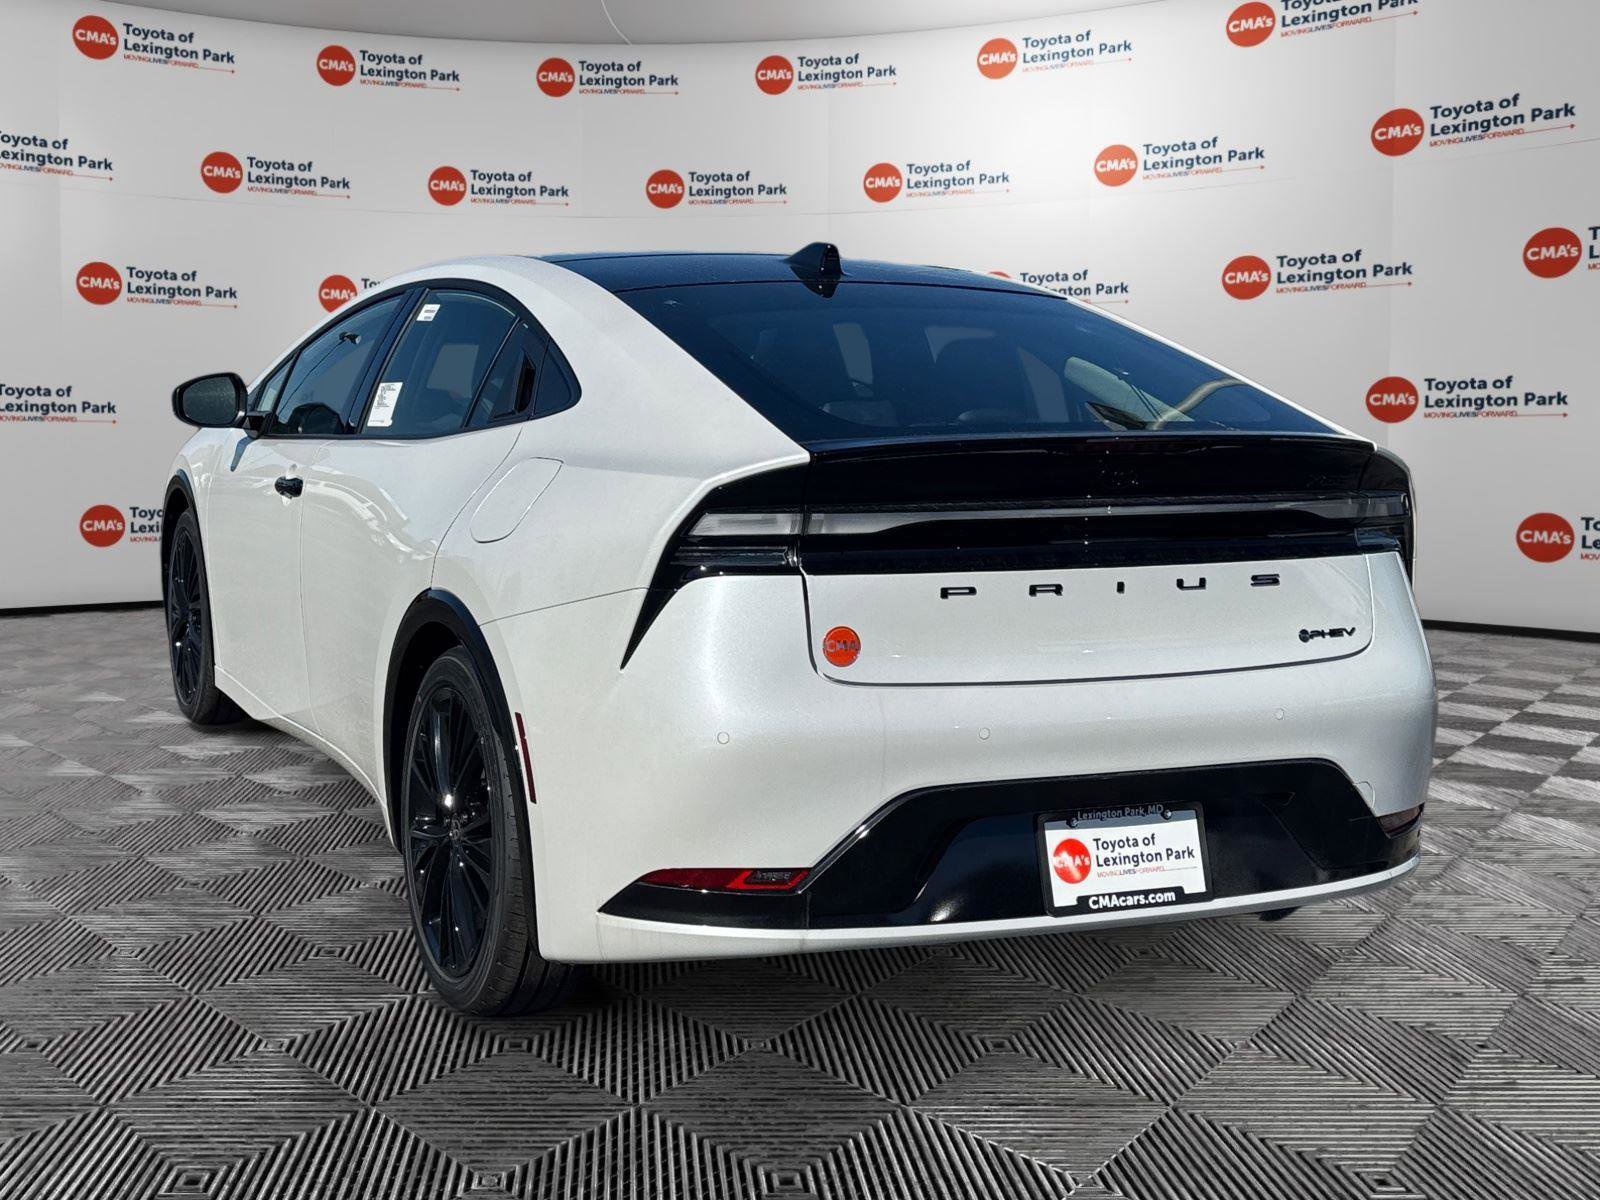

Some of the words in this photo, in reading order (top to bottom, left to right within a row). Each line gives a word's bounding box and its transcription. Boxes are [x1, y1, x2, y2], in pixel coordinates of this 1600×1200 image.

[1281, 2, 1372, 28] Lexington
[122, 22, 175, 41] Toyota
[177, 31, 194, 43] of
[1228, 15, 1273, 33] CMA's
[74, 29, 118, 48] CMA's
[1021, 33, 1072, 50] Toyota
[1074, 29, 1091, 42] of
[123, 38, 198, 64] Lexington
[202, 48, 235, 64] Park
[359, 49, 405, 65] Toyota
[407, 53, 423, 65] of
[978, 51, 1017, 65] CMA's
[1022, 46, 1094, 64] Lexington
[1098, 40, 1132, 55] Park
[318, 59, 355, 74] CMA's
[578, 60, 624, 74] Toyota
[626, 60, 642, 71] of
[796, 55, 842, 69] Toyota
[844, 52, 860, 64] of
[360, 64, 426, 84] Lexington
[430, 69, 460, 82] Park
[538, 71, 574, 84] CMA's
[578, 74, 645, 90] Lexington
[648, 74, 678, 86] Park
[757, 68, 793, 81] CMA's
[797, 68, 863, 83] Lexington
[866, 65, 896, 78] Park
[1429, 99, 1494, 120] Toyota
[1498, 92, 1520, 108] of
[1430, 113, 1524, 136] Lexington
[1530, 103, 1575, 122] Park
[0, 130, 48, 148] oyota
[52, 138, 69, 150] of
[1374, 123, 1423, 140] CMA's
[1142, 140, 1196, 157] Toyota
[1200, 135, 1218, 149] of
[0, 149, 74, 167] exington
[78, 155, 113, 171] Park
[246, 156, 294, 172] Toyota
[297, 160, 313, 172] of
[1096, 158, 1137, 172] CMA's
[1142, 154, 1222, 171] Lexington
[1227, 146, 1265, 162] Park
[202, 165, 242, 181] CMA's
[469, 169, 515, 184] Toyota
[517, 170, 532, 182] of
[905, 162, 953, 177] Toyota
[955, 159, 971, 171] of
[247, 171, 316, 191] Lexington
[320, 176, 350, 189] Park
[687, 171, 733, 185] Toyota
[735, 170, 750, 181] of
[864, 176, 902, 188] CMA's
[906, 175, 974, 190] Lexington
[978, 171, 1010, 185] Park
[429, 180, 466, 193] CMA's
[470, 183, 536, 200] Lexington
[539, 185, 569, 197] Park
[647, 183, 684, 195] CMA's
[688, 184, 754, 200] Lexington
[757, 183, 787, 195] Park
[1276, 252, 1337, 270] Toyota
[1341, 248, 1362, 262] of
[1526, 243, 1579, 261] CMA's
[125, 266, 178, 282] Toyota
[180, 270, 197, 282] of
[1020, 271, 1069, 285] Toyota
[1072, 269, 1089, 281] of
[1224, 270, 1270, 284] CMA's
[1276, 268, 1366, 284] Lexington
[1371, 261, 1414, 277] Park
[78, 276, 121, 292] CMA's
[126, 281, 201, 301] Lexington
[205, 285, 237, 299] Park
[1095, 282, 1129, 295] Park
[55, 385, 73, 397] of
[1423, 377, 1487, 394] Toyota
[1491, 374, 1513, 389] of
[81, 401, 117, 414] Park
[1369, 392, 1417, 407] CMA's
[1424, 394, 1518, 412] Lexington
[1524, 391, 1568, 406] Park
[82, 519, 124, 532] CMA's
[1520, 529, 1571, 545] CMA's
[940, 573, 1280, 600] PRIUS
[1310, 626, 1356, 639] PHEV
[1077, 810, 1123, 821] Lexington
[1147, 804, 1164, 814] MD
[1093, 837, 1140, 853] Toyota
[1142, 833, 1157, 847] of
[1095, 851, 1163, 868] Lexington
[1165, 846, 1196, 861] Park
[1088, 890, 1176, 910] CMAcars.com
